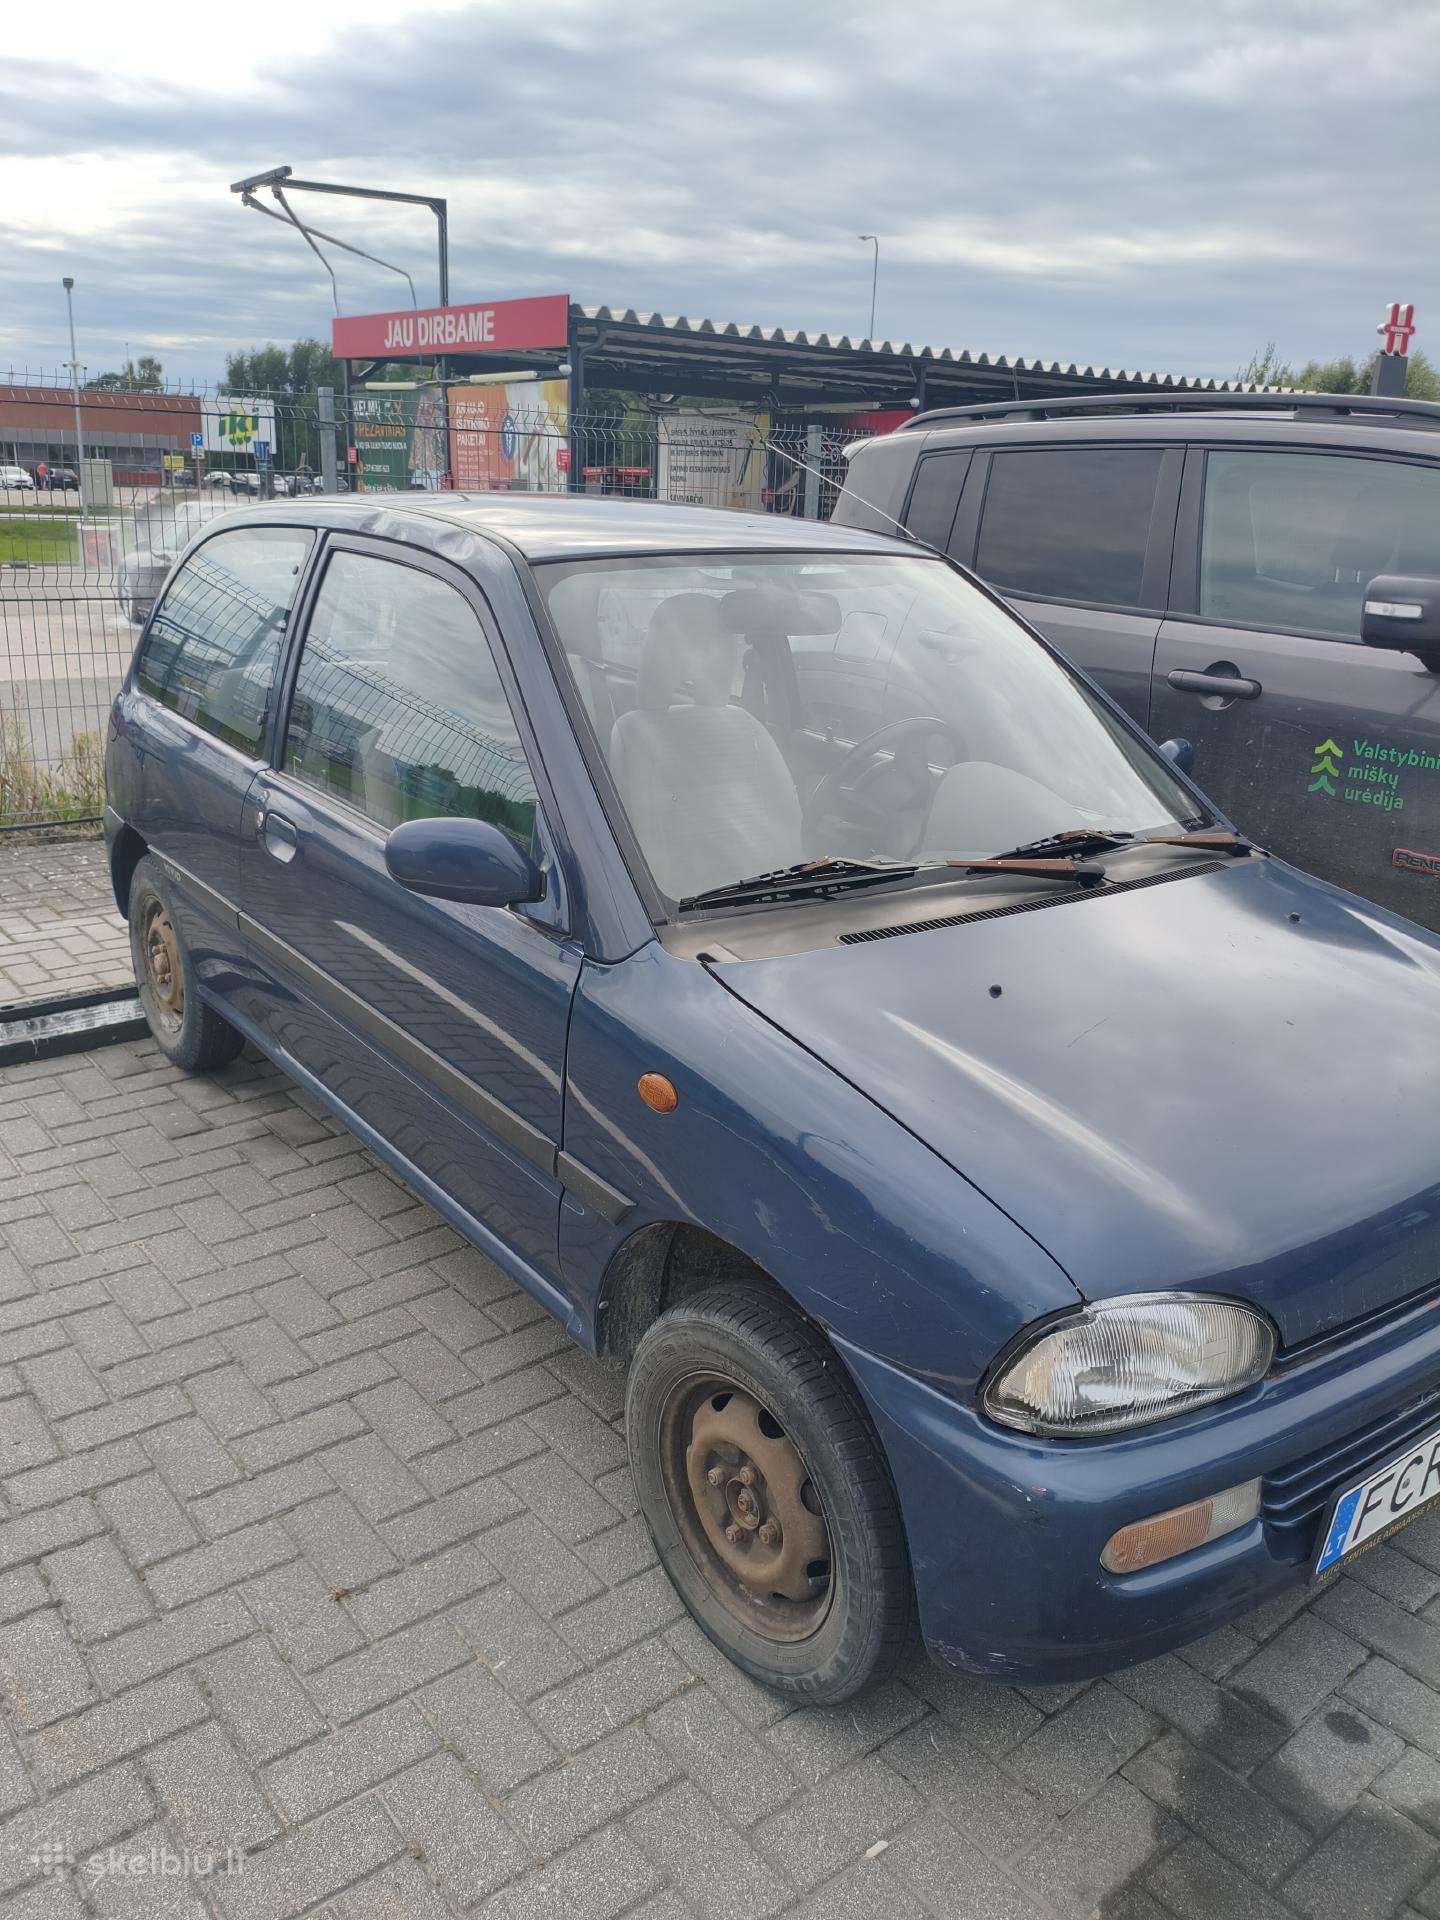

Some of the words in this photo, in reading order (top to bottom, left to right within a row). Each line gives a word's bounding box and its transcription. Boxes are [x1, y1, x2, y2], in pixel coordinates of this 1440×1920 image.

[384, 318, 414, 348] JAU
[418, 311, 495, 346] DIRBAME
[1348, 766, 1400, 789] miškų
[1344, 788, 1404, 811] urėdija
[1323, 1532, 1347, 1558] LT
